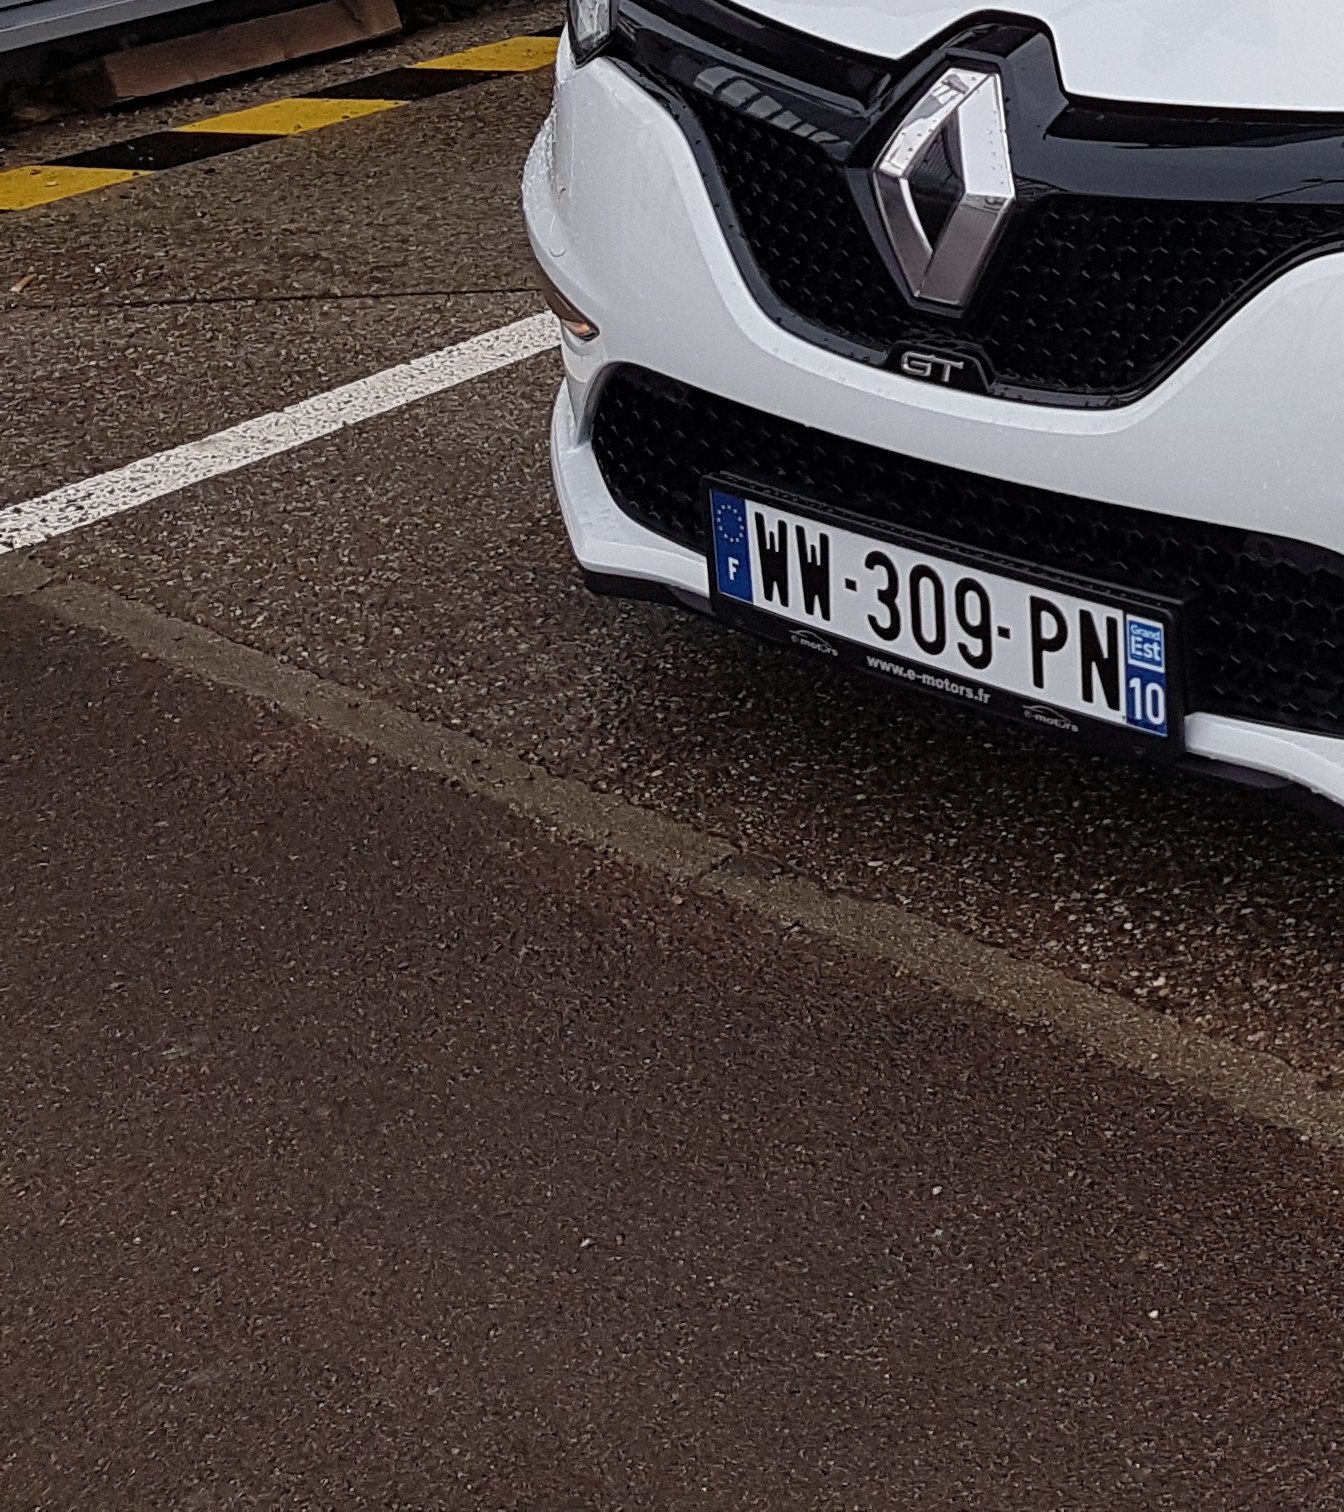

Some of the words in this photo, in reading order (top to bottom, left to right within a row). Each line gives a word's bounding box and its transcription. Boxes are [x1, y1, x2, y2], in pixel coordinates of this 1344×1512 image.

[901, 351, 964, 383] GT
[727, 556, 740, 581] F
[754, 511, 1121, 712] WW-309-PN
[1130, 624, 1161, 640] Grand
[1130, 635, 1162, 661] Est
[866, 655, 992, 704] www.e-motors.fr
[1129, 677, 1165, 725] 10
